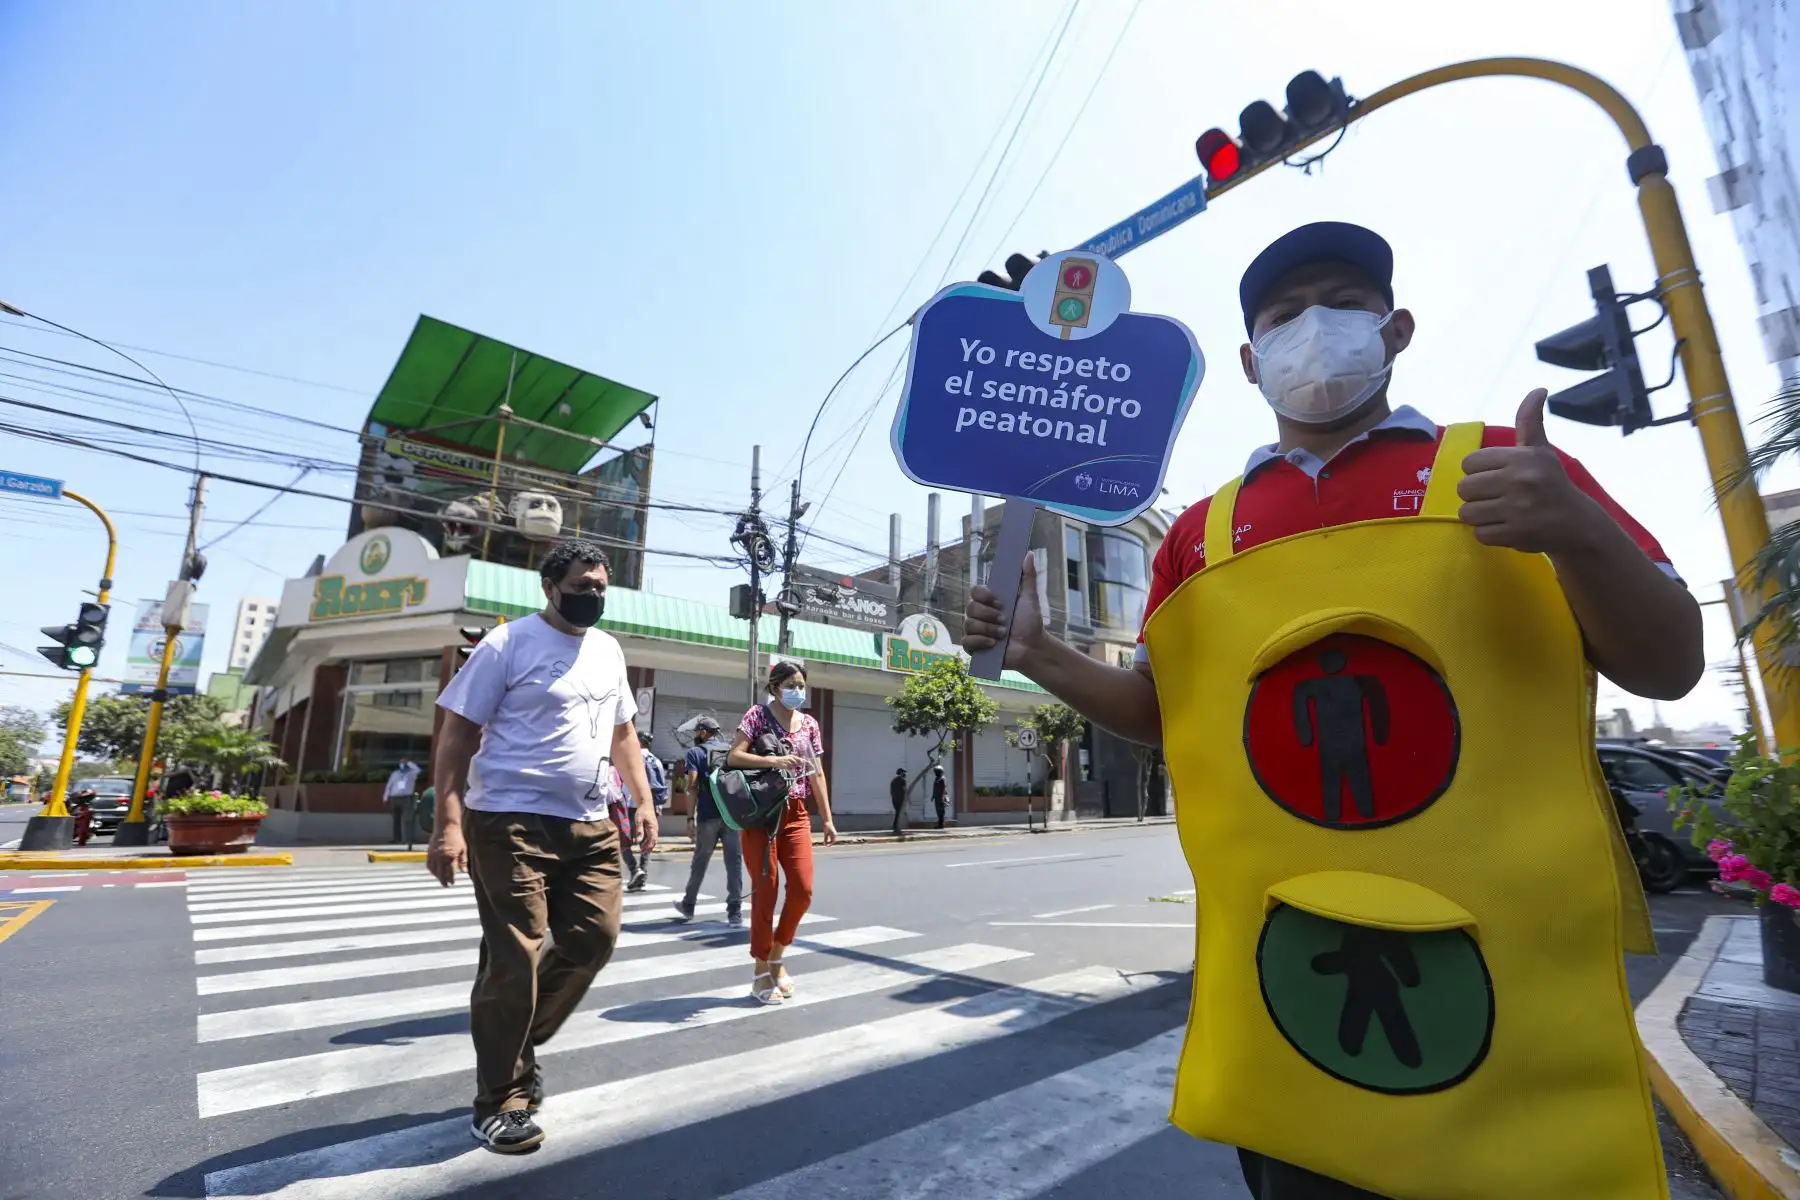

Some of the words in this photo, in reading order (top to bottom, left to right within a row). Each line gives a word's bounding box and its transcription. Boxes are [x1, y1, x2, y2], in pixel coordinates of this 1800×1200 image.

[1137, 191, 1196, 234] Dominicana
[959, 337, 996, 365] Yo
[1004, 349, 1131, 382] respeto
[944, 370, 974, 396] el
[981, 379, 1142, 419] semáforo
[954, 406, 1108, 447] peatonal
[1100, 482, 1139, 498] LIMA
[806, 605, 838, 617] karaoke
[842, 611, 855, 620] bar
[864, 616, 887, 625] boxes
